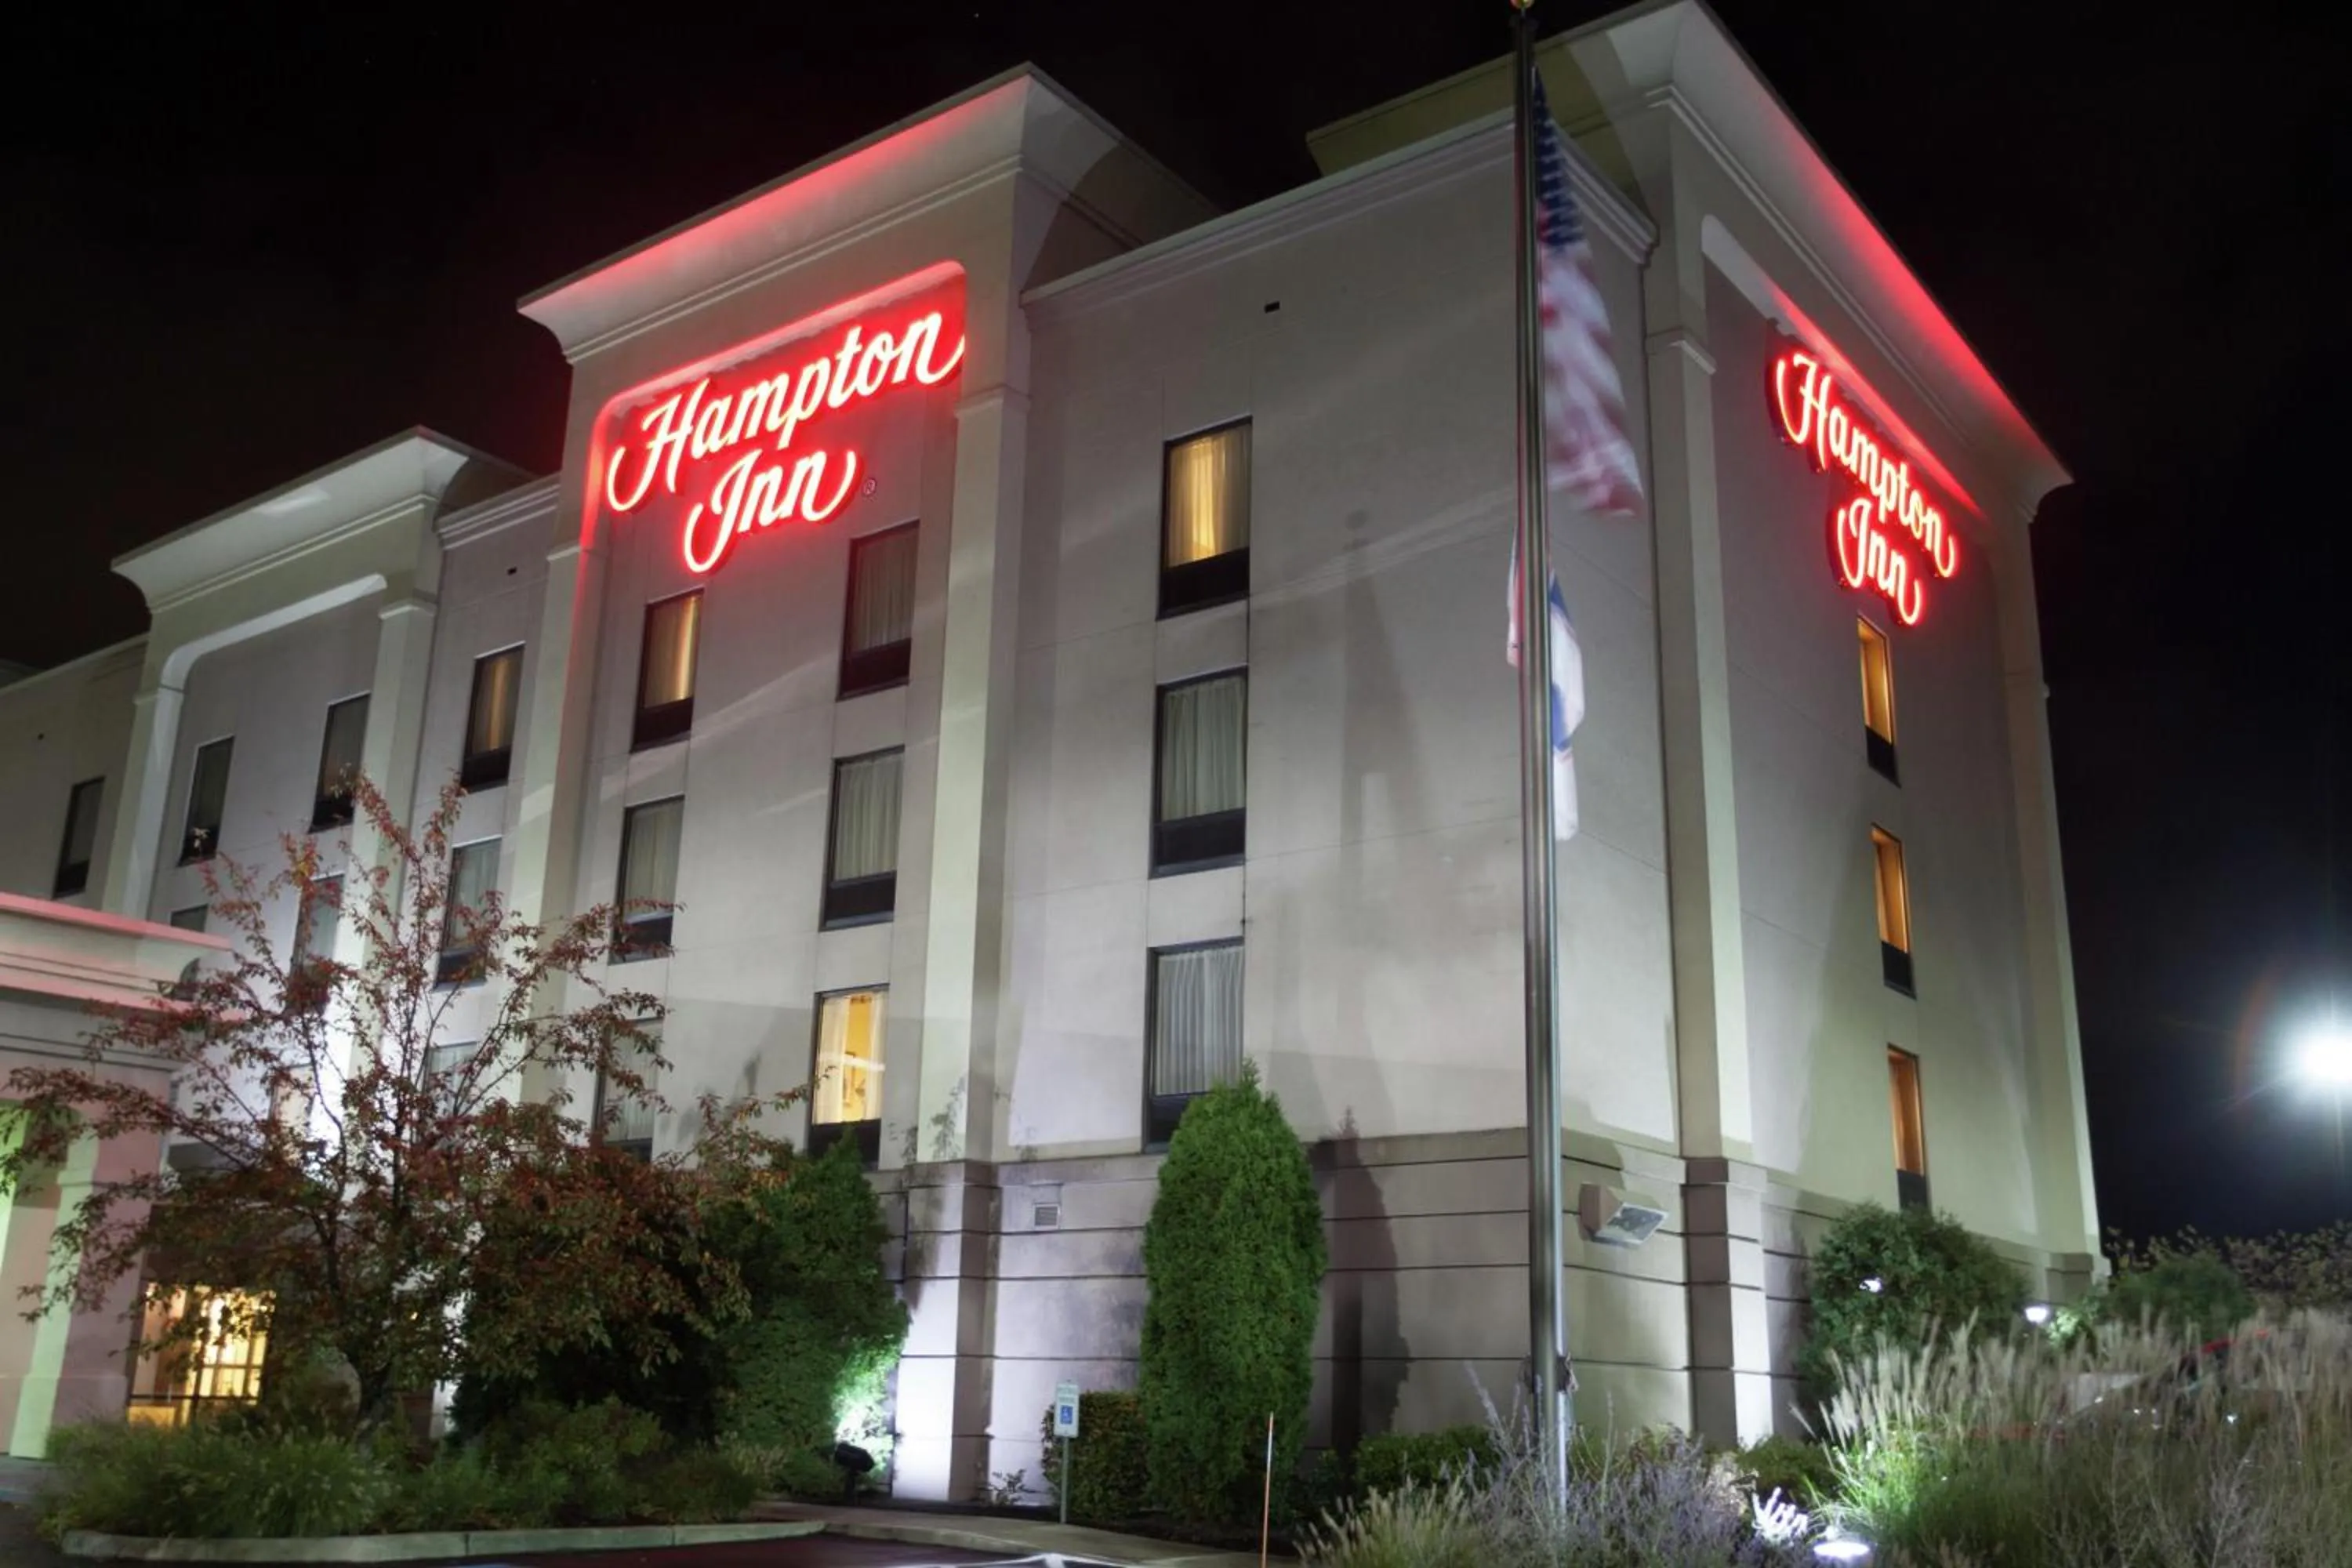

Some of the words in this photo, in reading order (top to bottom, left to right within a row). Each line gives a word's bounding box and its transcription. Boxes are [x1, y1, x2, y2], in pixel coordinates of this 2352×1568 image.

[608, 312, 965, 511] Hampton
[1777, 354, 1955, 578] Hampton
[684, 449, 856, 572] Inn
[1837, 498, 1921, 626] Inn
